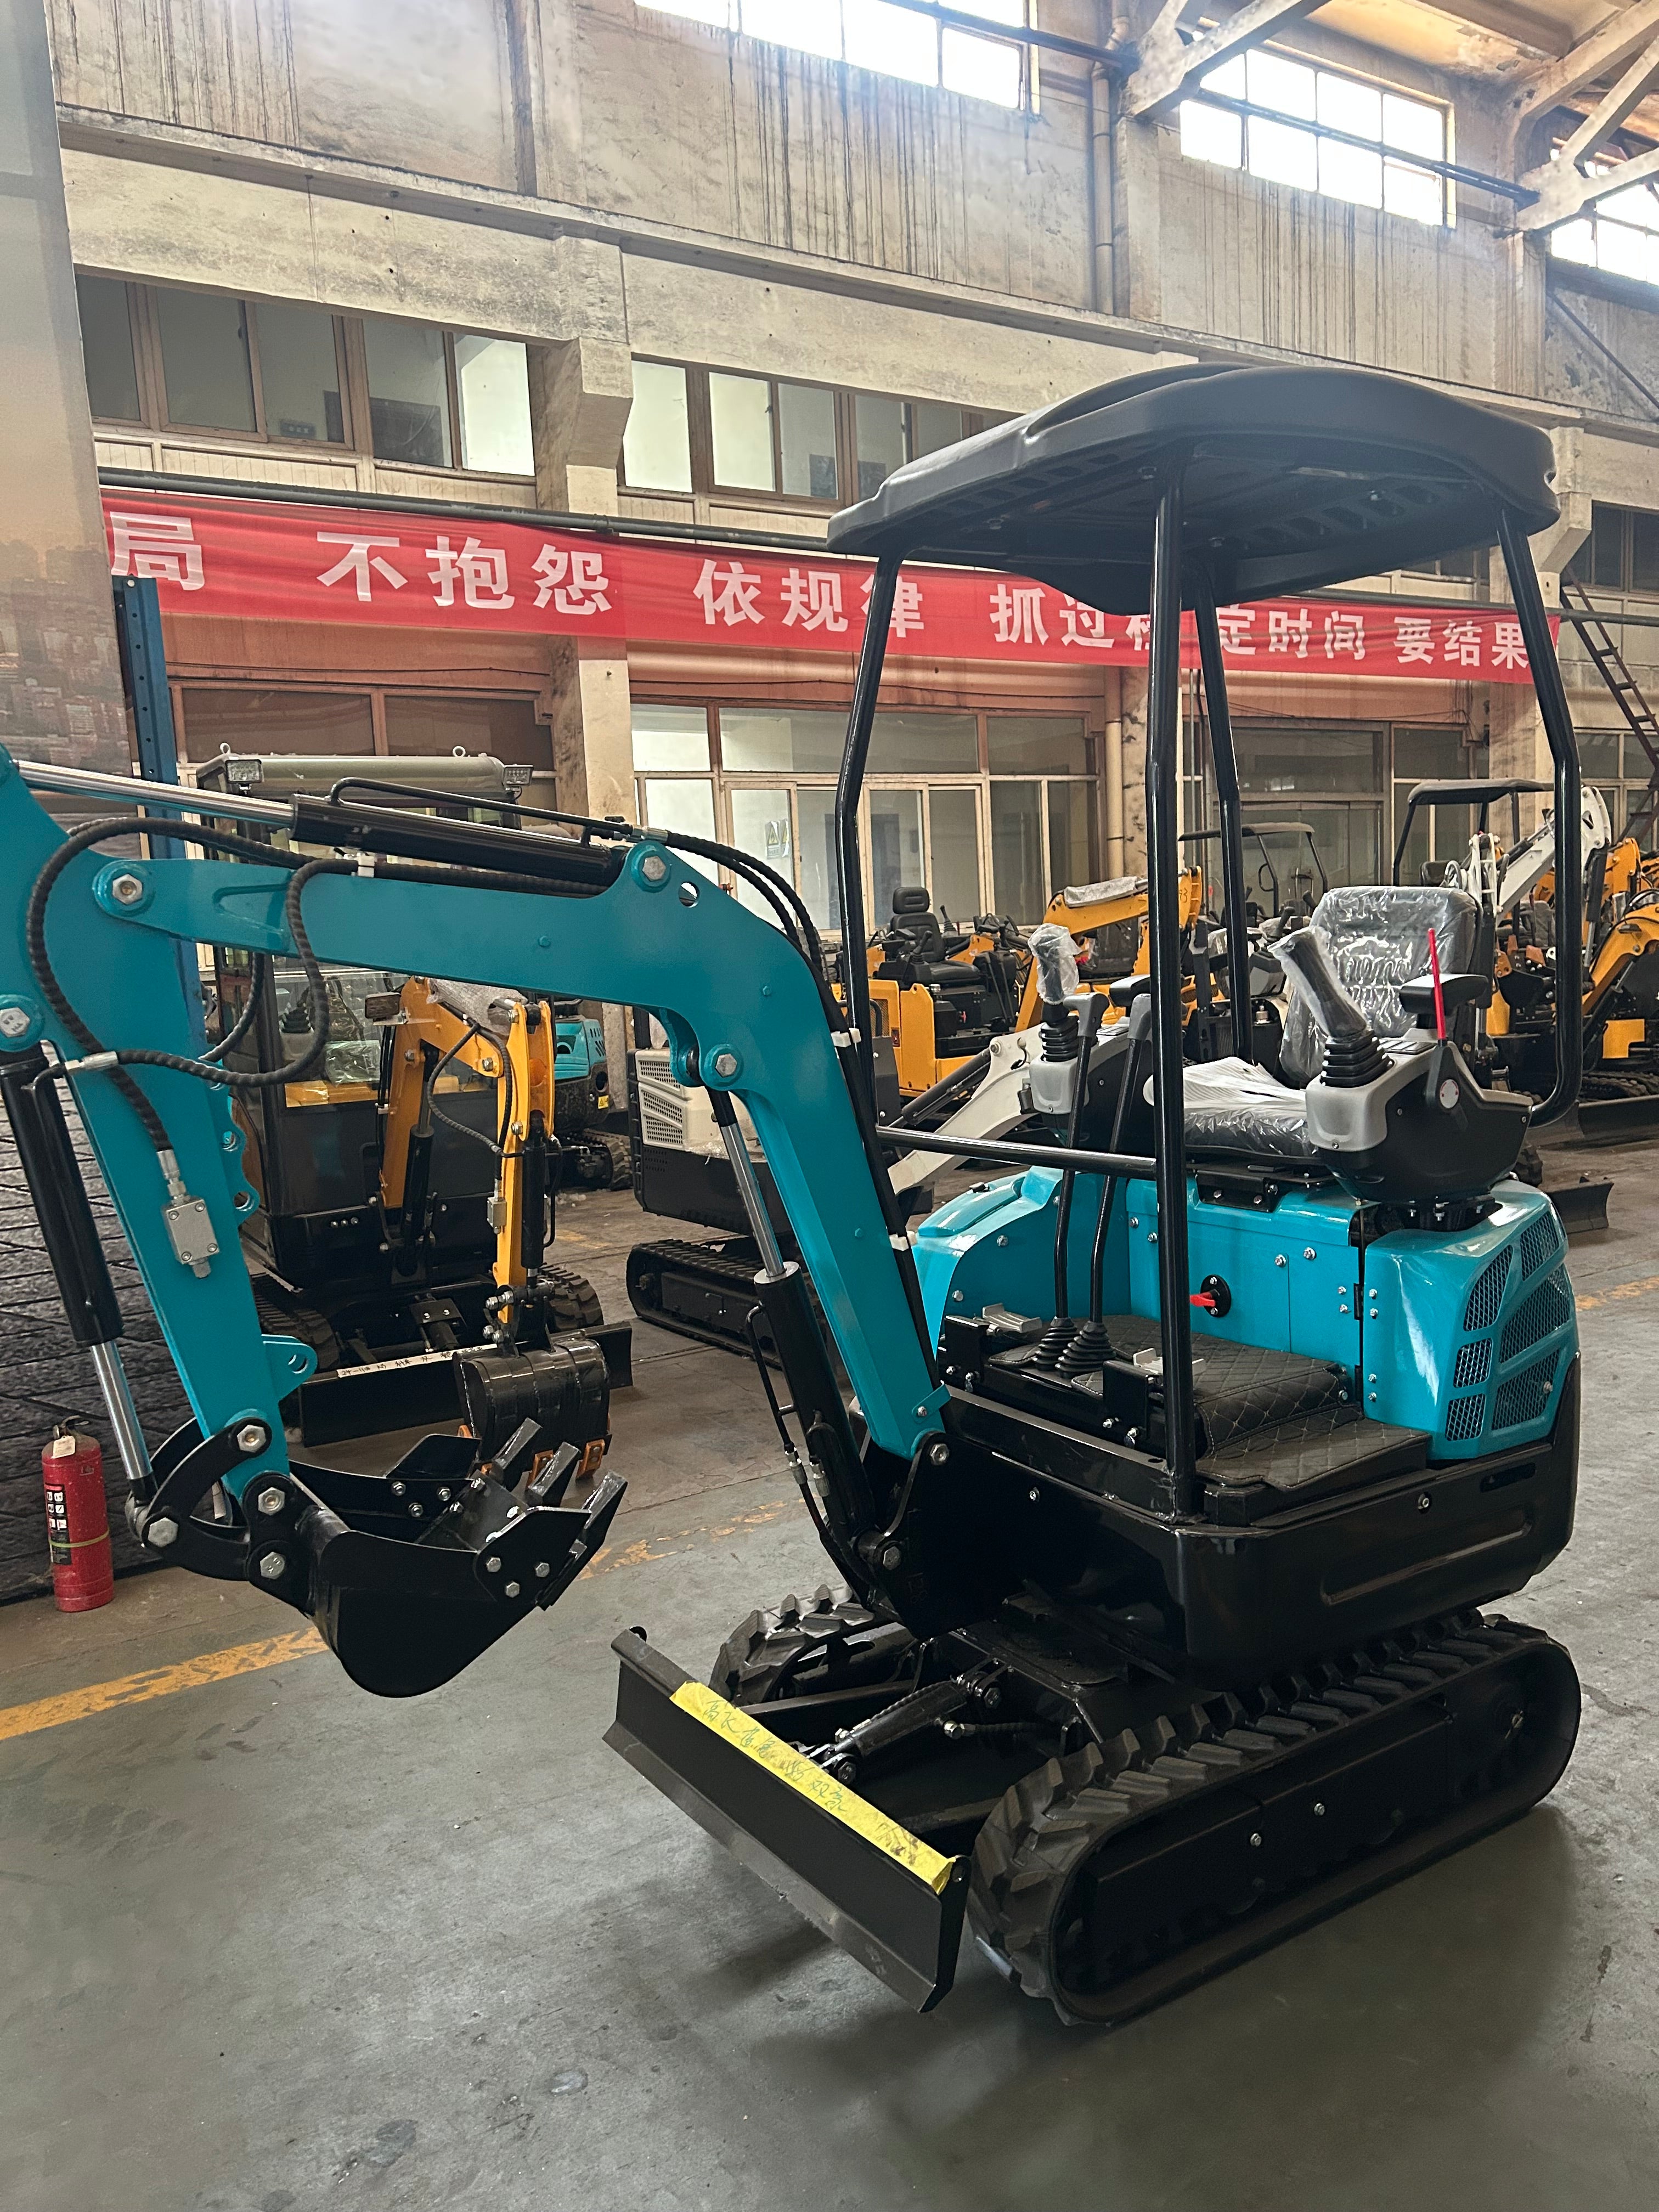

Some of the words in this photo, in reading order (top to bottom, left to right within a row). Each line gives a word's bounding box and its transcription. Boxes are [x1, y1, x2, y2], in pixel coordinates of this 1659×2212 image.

[110, 510, 205, 591] 局
[317, 530, 612, 615] 不抱怨
[1393, 617, 1529, 669] 要结果
